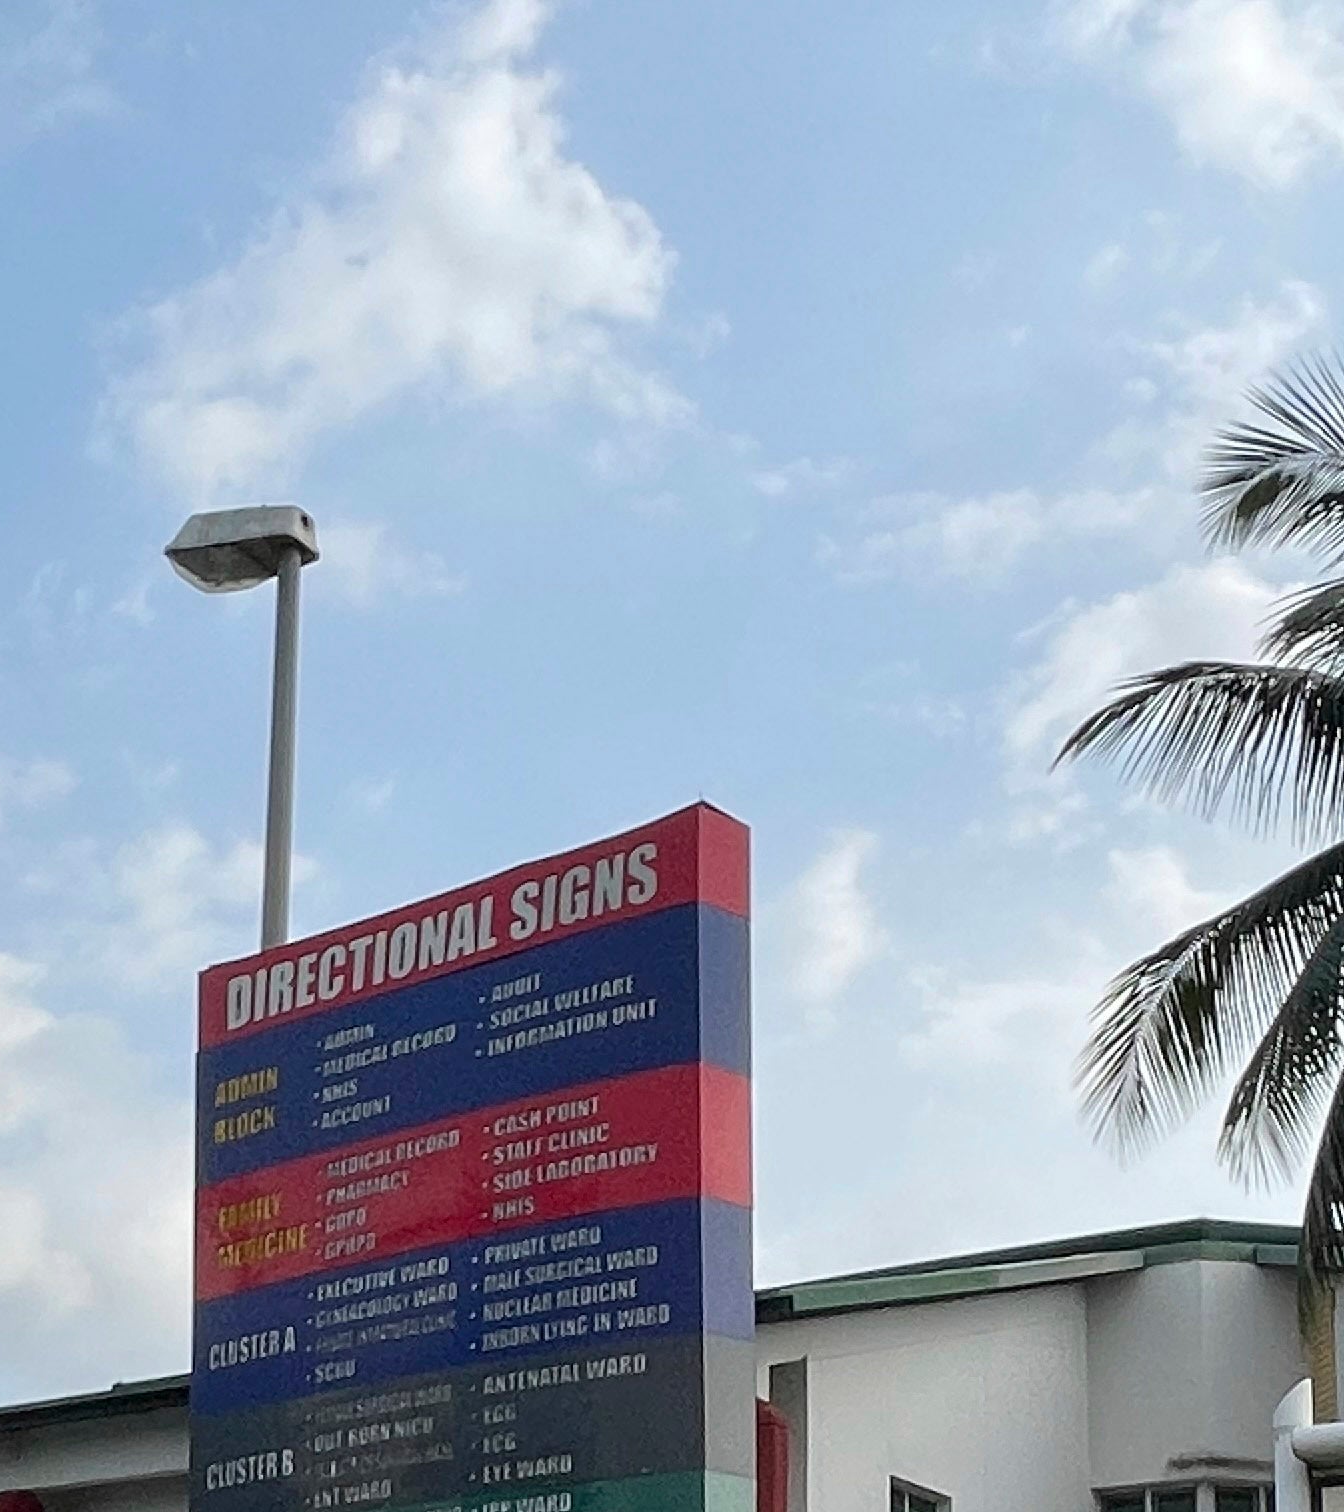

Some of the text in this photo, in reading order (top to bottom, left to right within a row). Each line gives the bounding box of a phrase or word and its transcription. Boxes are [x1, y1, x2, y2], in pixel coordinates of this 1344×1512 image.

[226, 843, 657, 1031] DIRECTIONAL SIGNS
[489, 974, 635, 1030] SOCIAL WELFARE
[491, 972, 541, 1002] AUDIT
[488, 998, 657, 1057] INFORMATION UNIT
[322, 1024, 456, 1077] MEDICAL RECORD
[215, 1067, 279, 1107] ADMIN
[214, 1106, 276, 1142] BLOCK
[321, 1095, 391, 1129] ACCOUNT
[494, 1096, 600, 1136] CASH POINT
[327, 1129, 460, 1176] MEDICAL RECORD
[492, 1122, 609, 1165] STAFF CLINIC
[326, 1170, 408, 1205] PHARMACY
[492, 1143, 657, 1193] SIDE LABORATORY
[492, 1196, 534, 1223] NHIS
[484, 1226, 601, 1264] PRIVATE WARD
[317, 1256, 450, 1302] EXECUTIVE WARD
[483, 1246, 658, 1294] MALE SURGICAL WARD
[483, 1277, 638, 1322] NUCLEAR MEDICINE
[209, 1330, 280, 1370] CLUSTER
[283, 1326, 296, 1352] A
[483, 1353, 646, 1395] ANTENATAL WARD
[207, 1452, 278, 1490] CLUSTER
[282, 1449, 294, 1475] B
[483, 1454, 572, 1484] EYE WARD
